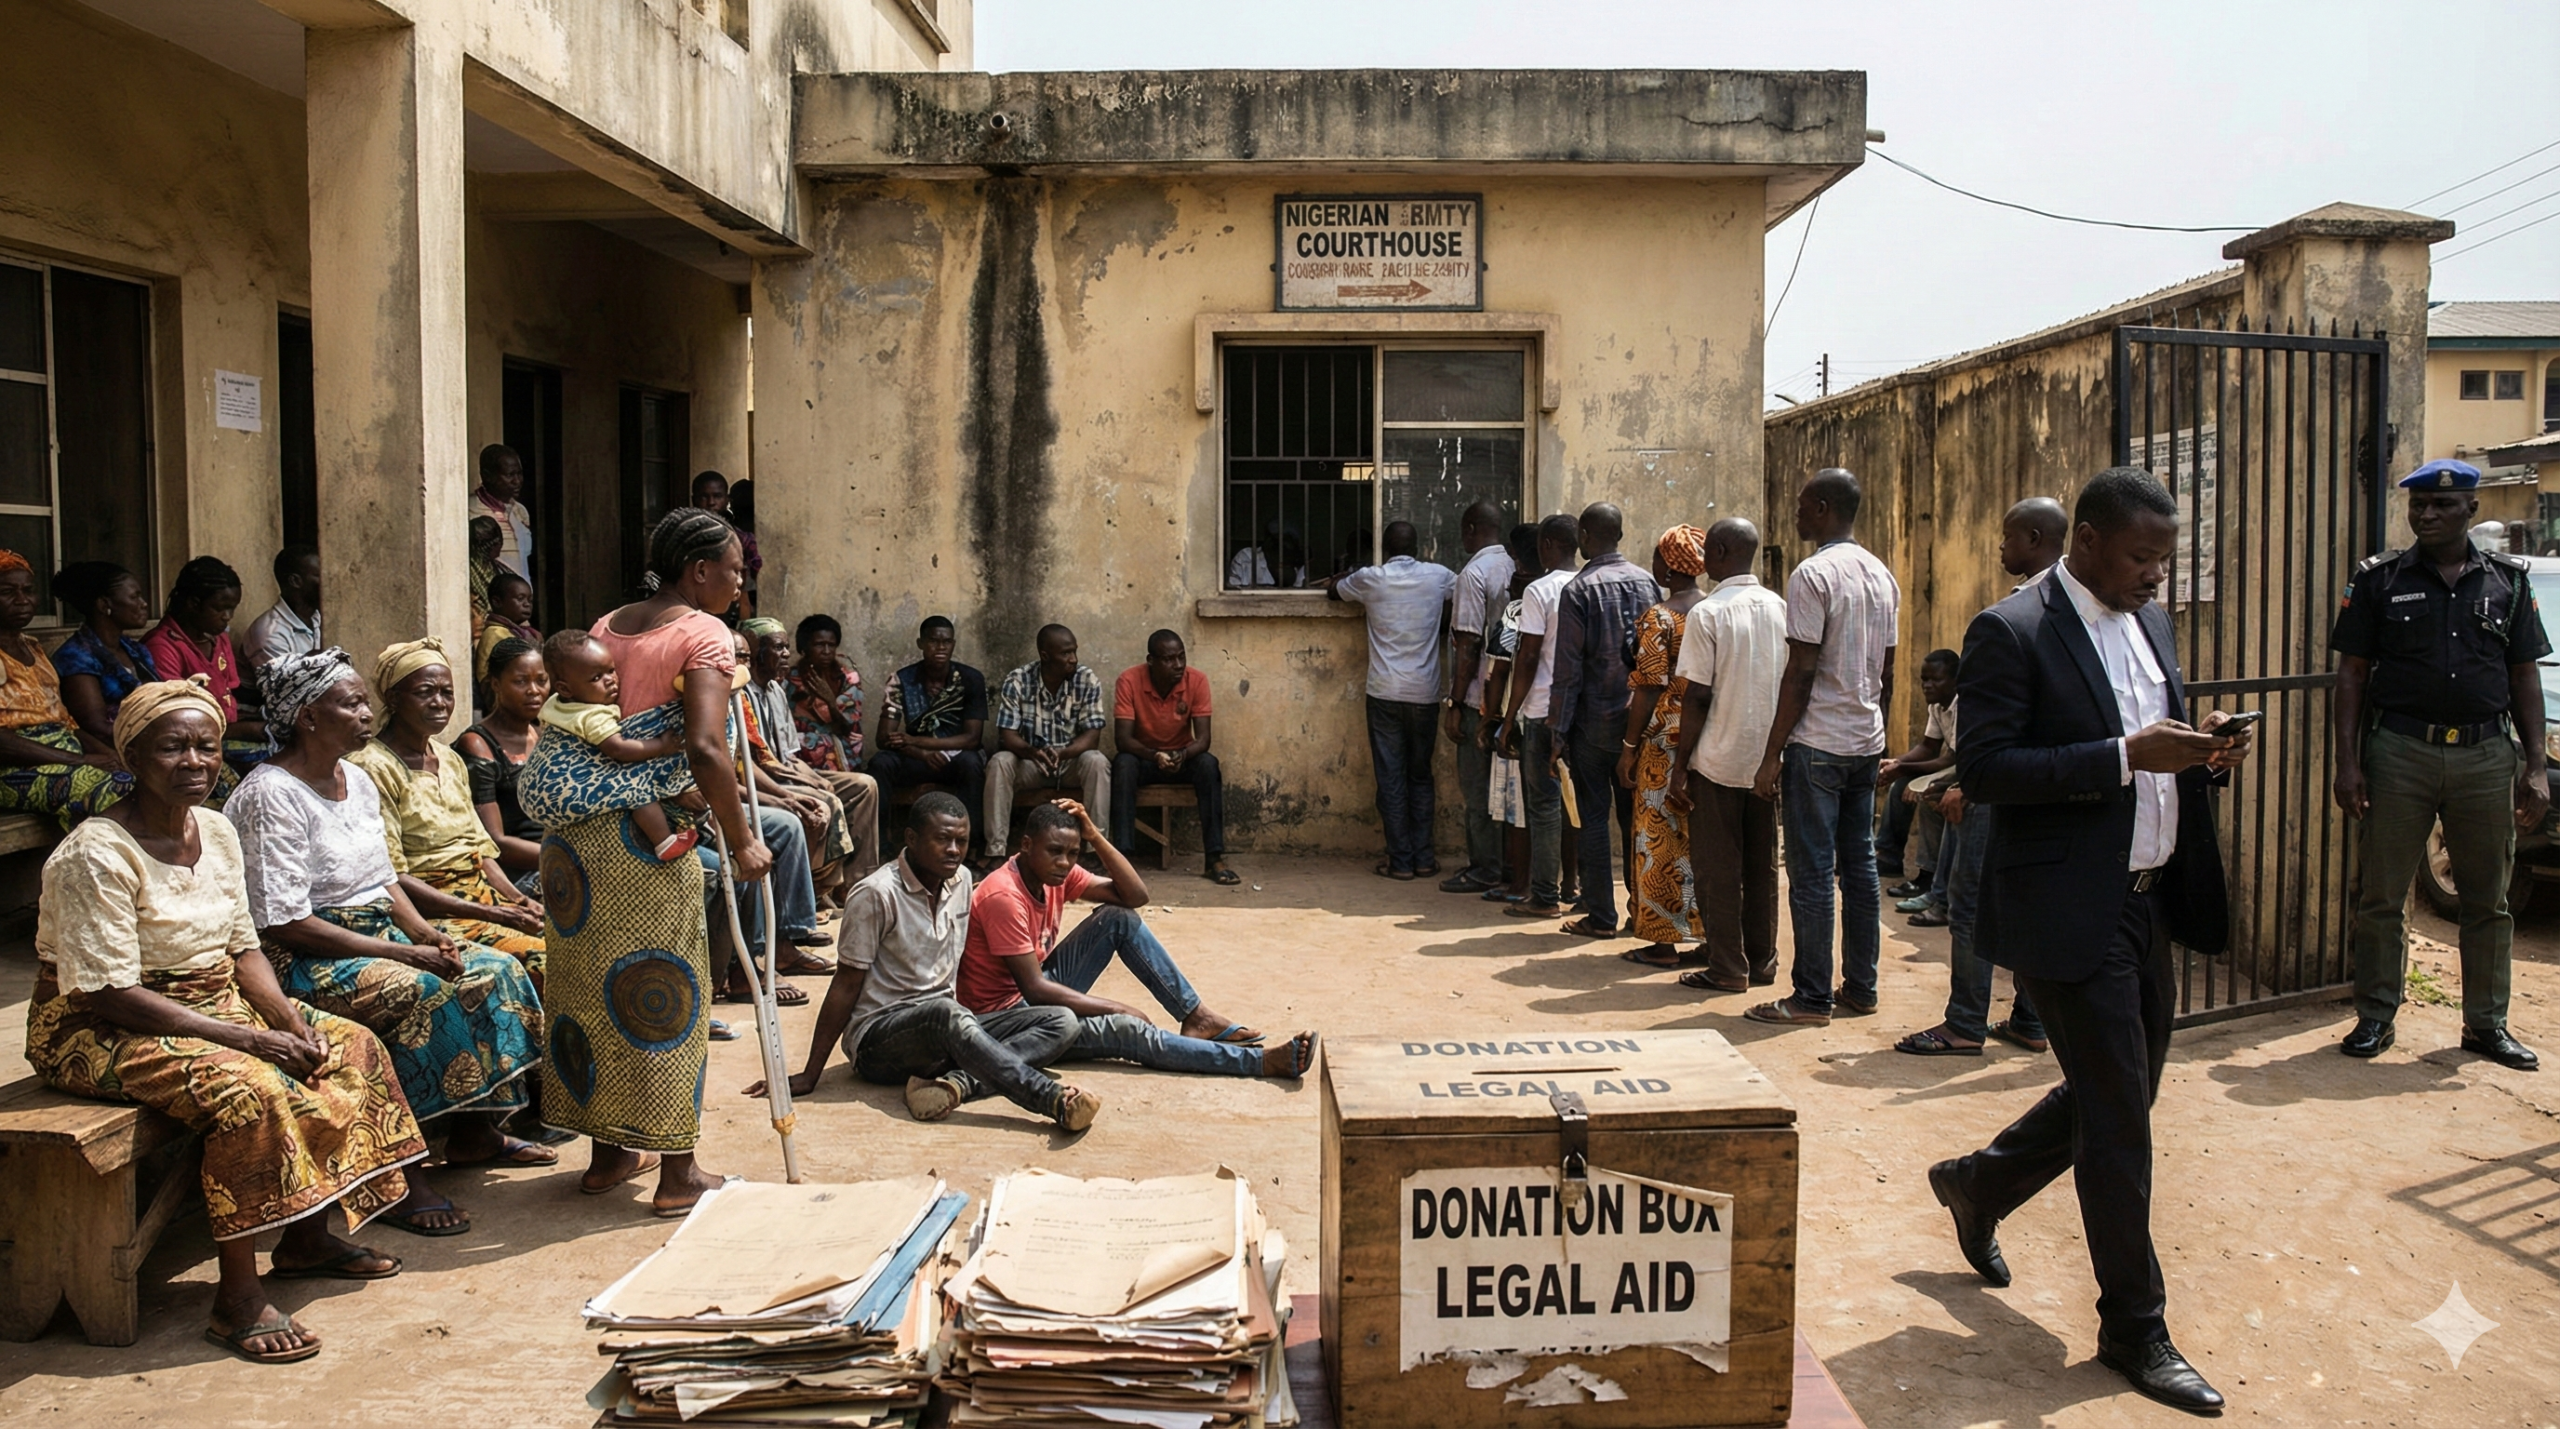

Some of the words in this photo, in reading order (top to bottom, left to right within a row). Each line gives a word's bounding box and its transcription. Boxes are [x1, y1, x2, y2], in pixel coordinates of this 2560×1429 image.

[1286, 203, 1389, 227] NIGERIAN
[1296, 231, 1462, 258] COURTHOUSE
[1401, 1039, 1642, 1056] DONATION
[1593, 1078, 1671, 1095] AID
[1412, 1184, 1624, 1239] DONATION
[1639, 1184, 1721, 1234] BOX
[1437, 1263, 1596, 1319] LEGAL
[1610, 1261, 1696, 1314] AID
